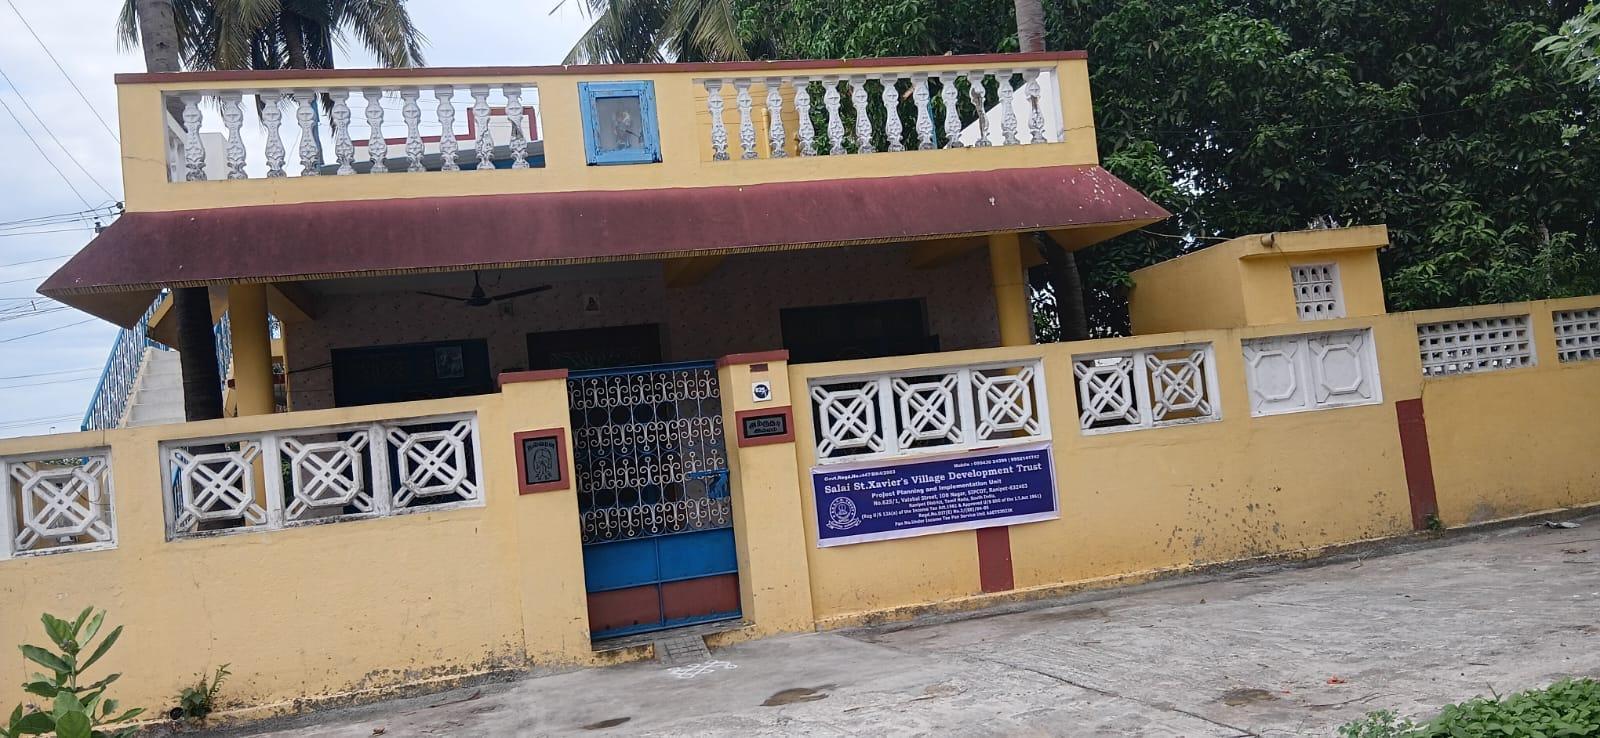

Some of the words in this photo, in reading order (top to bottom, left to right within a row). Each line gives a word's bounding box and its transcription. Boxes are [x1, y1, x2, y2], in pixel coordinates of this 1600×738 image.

[825, 483, 850, 494] Salai
[854, 478, 908, 491] St.Xavier's
[912, 474, 945, 484] Village
[948, 466, 1014, 480] Development
[1016, 463, 1042, 472] Trust
[872, 490, 895, 499] Project
[897, 487, 924, 496] Planning
[939, 480, 987, 491] Implementation
